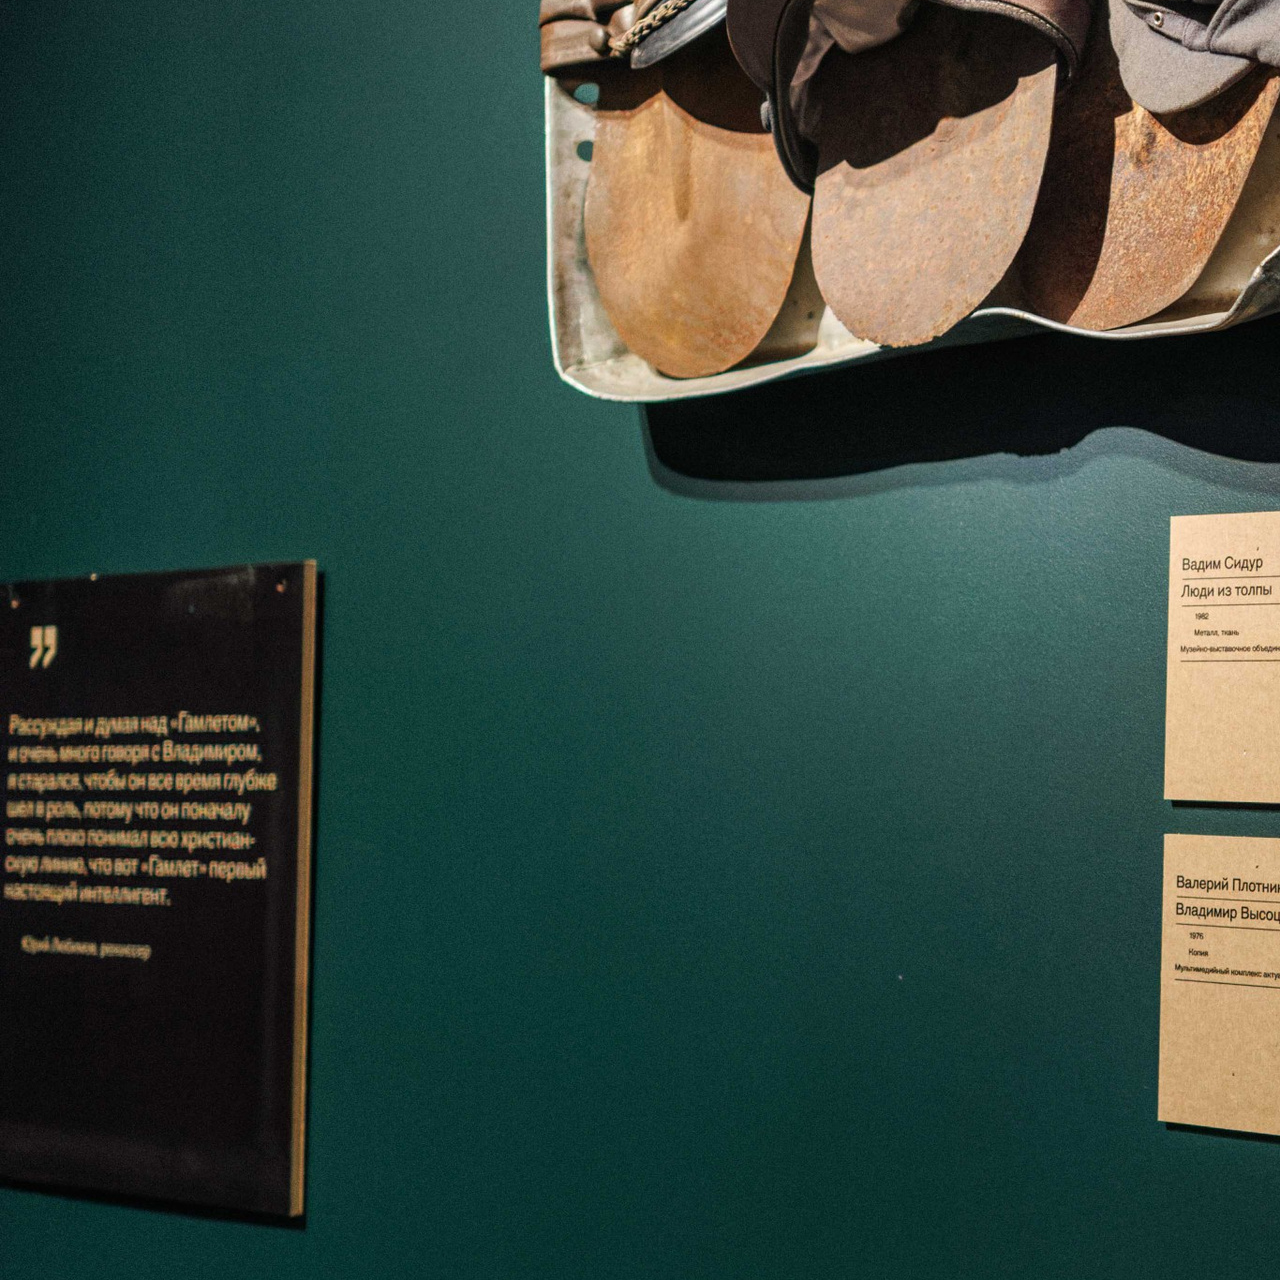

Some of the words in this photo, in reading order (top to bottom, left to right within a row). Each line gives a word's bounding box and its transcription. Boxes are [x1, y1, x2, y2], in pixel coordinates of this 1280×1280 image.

[1182, 557, 1221, 573] Вадим
[1224, 556, 1263, 572] Сидур
[1181, 584, 1214, 599] Люди
[1217, 586, 1232, 596] из
[1235, 585, 1272, 596] толпы
[1194, 628, 1219, 637] Металл,
[1221, 629, 1239, 637] ткань
[1180, 643, 1251, 654] Музейно-выставочное
[95, 716, 139, 738] думая
[140, 715, 168, 737] над
[59, 744, 99, 763] много
[101, 744, 149, 766] говоря
[151, 744, 161, 762] с
[83, 768, 127, 791] чтобы
[128, 772, 146, 791] он
[148, 772, 173, 791] все
[175, 772, 221, 795] время
[223, 767, 277, 796] глубже
[83, 801, 133, 824] потому
[134, 802, 159, 820] что
[161, 802, 179, 820] он
[181, 802, 251, 825] поначалу
[46, 828, 86, 847] плохо
[87, 829, 148, 848] понимал
[88, 857, 112, 876] что
[114, 857, 139, 876] вот
[209, 857, 267, 883] первый
[1176, 875, 1229, 893] Валерий
[1176, 902, 1237, 922] Владимир
[1189, 932, 1204, 940] 1976
[1188, 948, 1208, 957] Копия
[1175, 964, 1229, 975] Мультимедийный
[1231, 969, 1262, 978] комплекс
